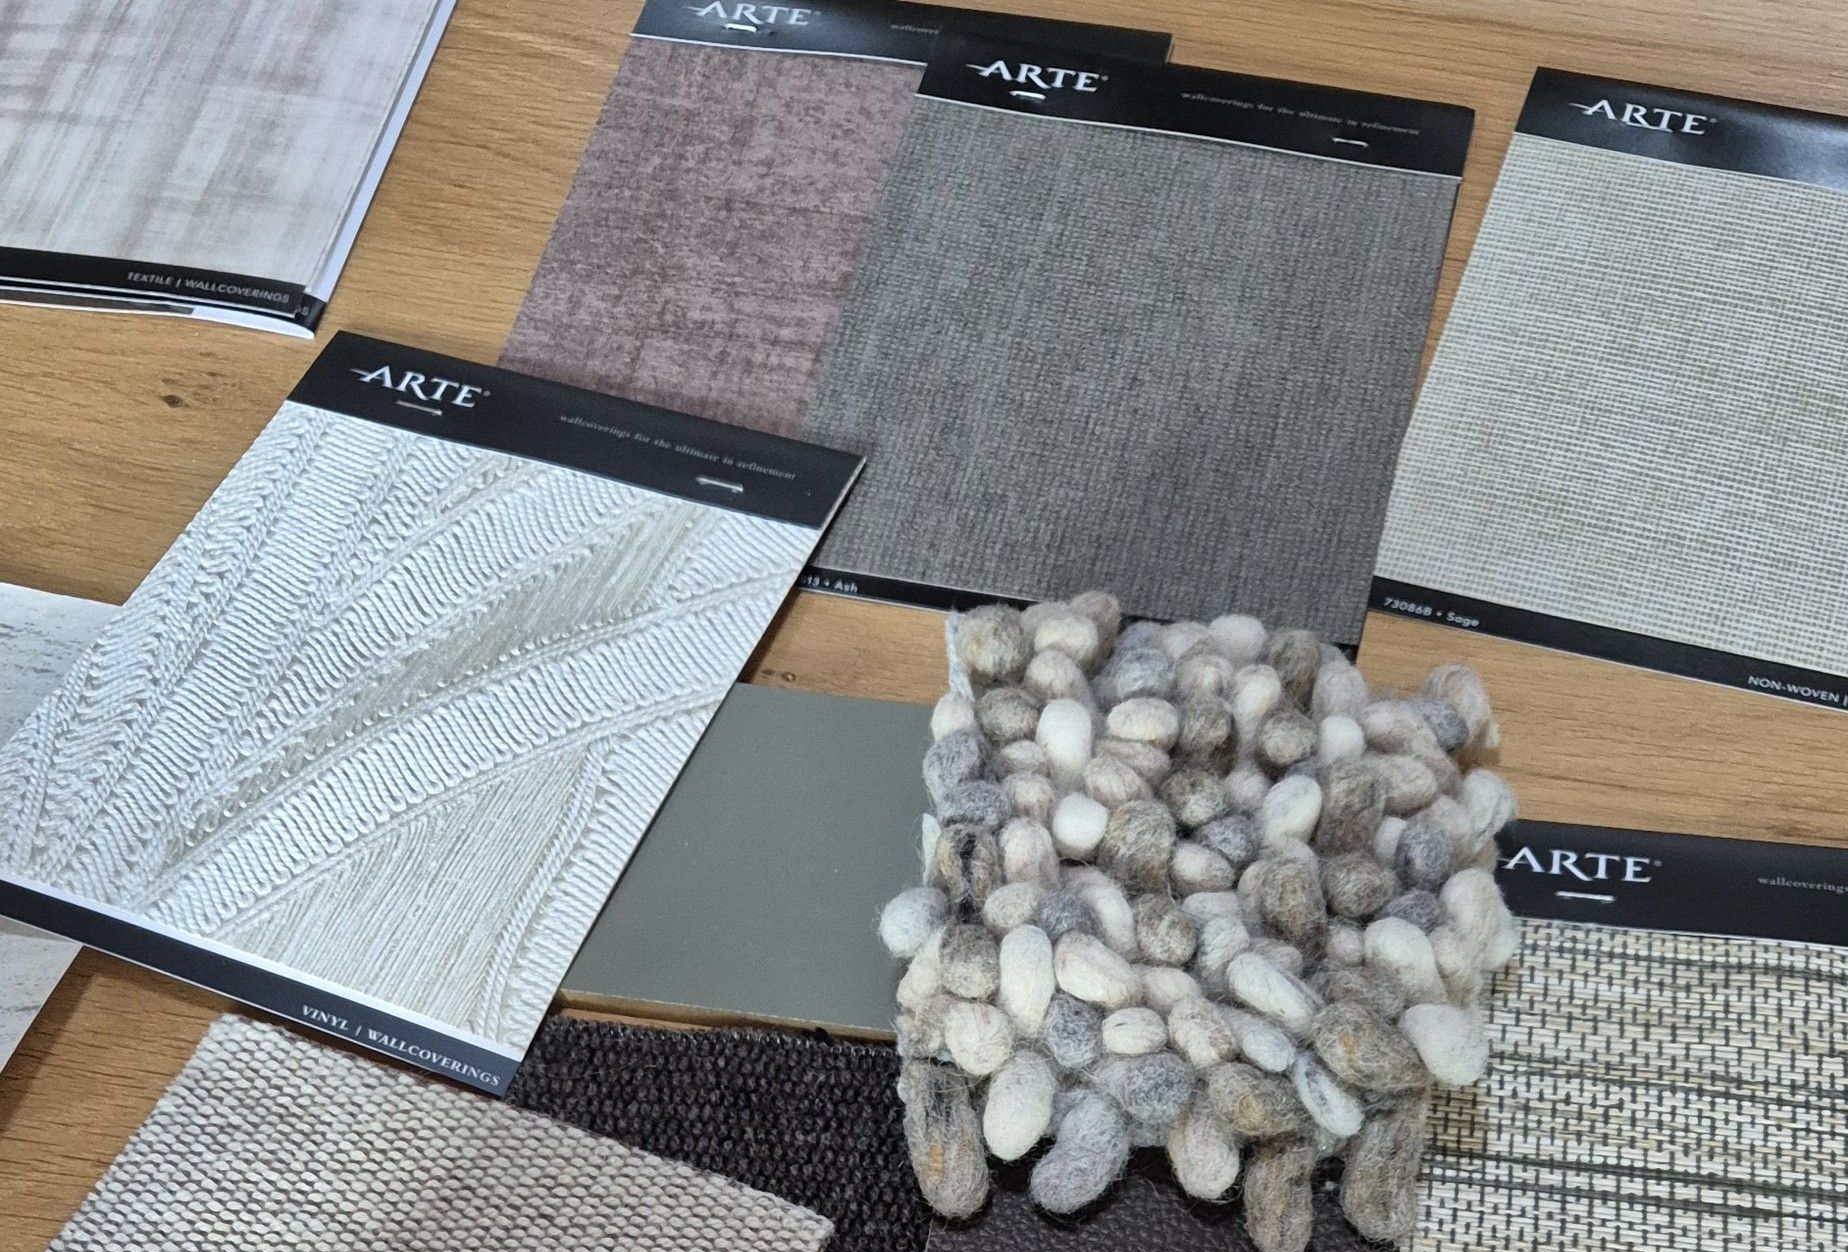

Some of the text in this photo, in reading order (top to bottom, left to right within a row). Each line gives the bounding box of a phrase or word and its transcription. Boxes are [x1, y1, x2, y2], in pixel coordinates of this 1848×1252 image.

[684, 0, 812, 26] ARTE
[966, 60, 1100, 92] ARTE
[1569, 99, 1708, 135] ARTE
[127, 271, 290, 304] TEXTILE WALLCOVERINGS
[350, 365, 483, 408] ARTE
[1446, 611, 1479, 627] Sage
[1747, 675, 1840, 703] NON-WOVEN
[1500, 846, 1652, 883] ARTE
[302, 1004, 501, 1088] VINYL WALLCOVERINGS
